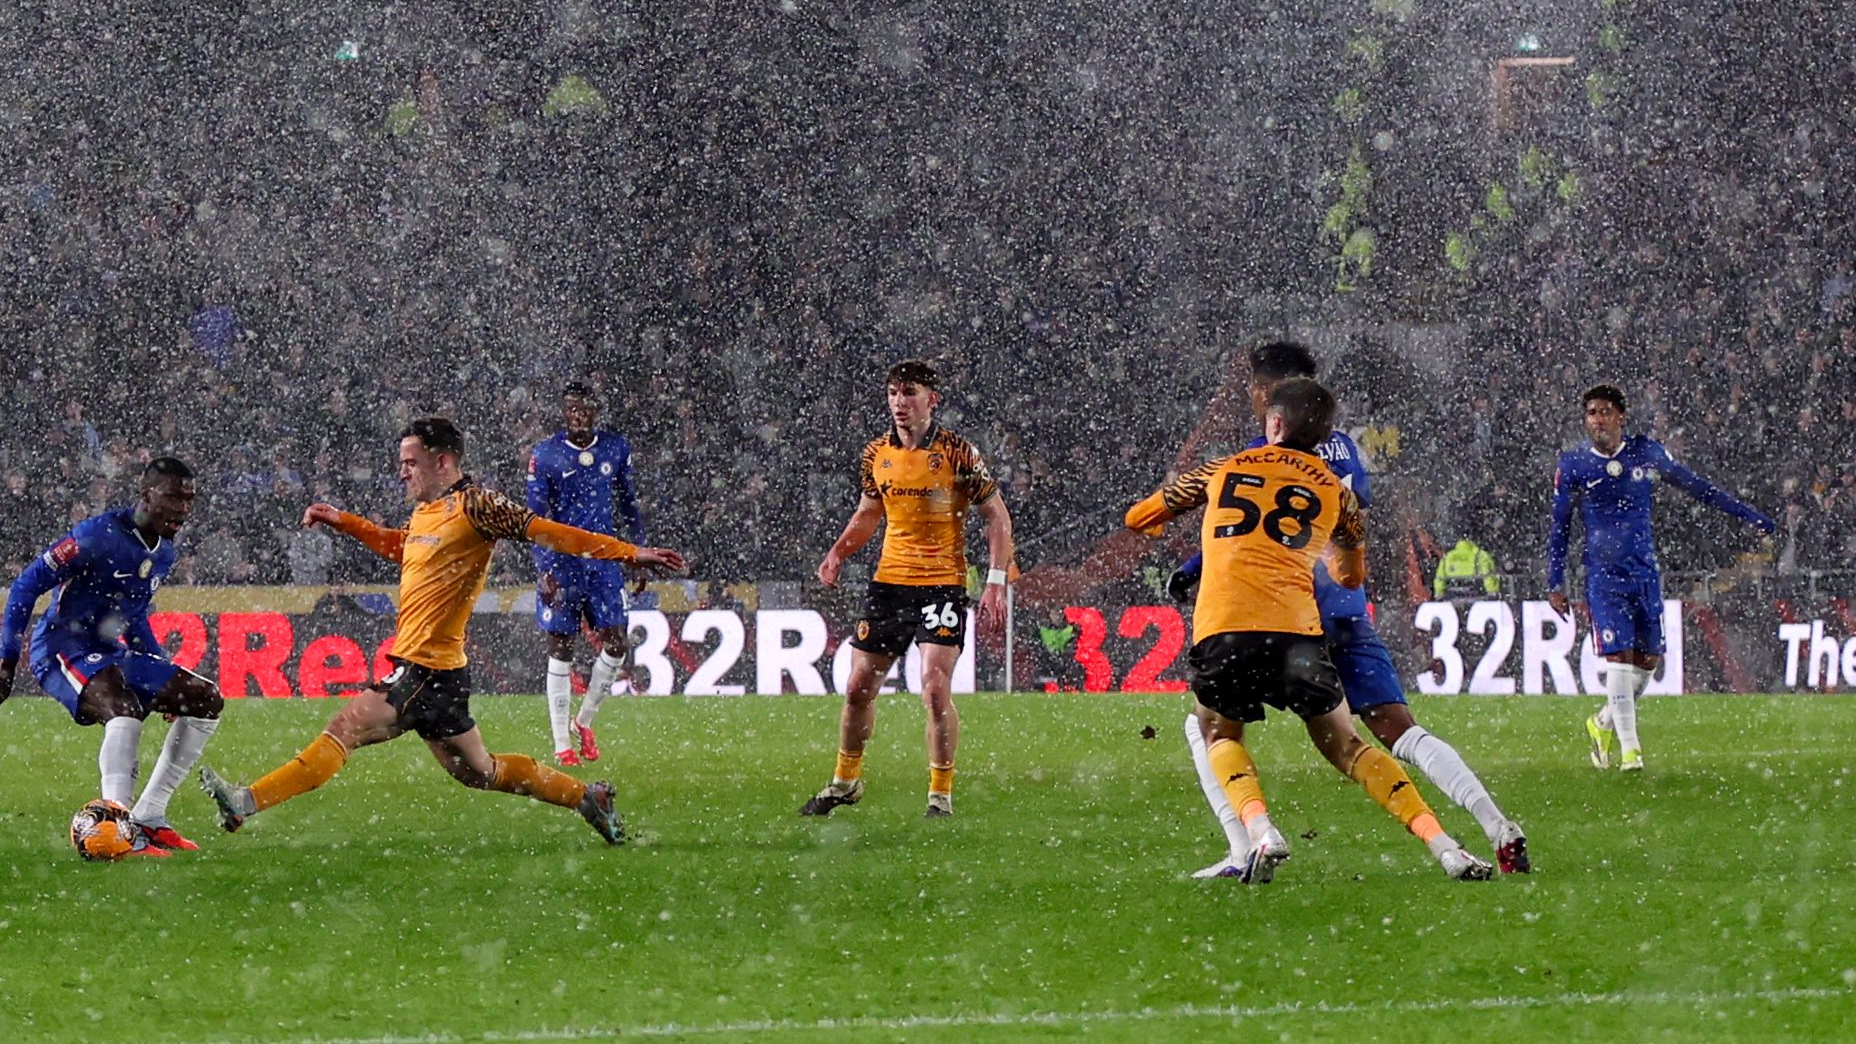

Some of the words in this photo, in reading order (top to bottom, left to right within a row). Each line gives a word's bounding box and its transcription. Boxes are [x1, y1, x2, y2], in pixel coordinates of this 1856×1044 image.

[1236, 453, 1334, 486] McCARTHY
[1213, 472, 1322, 549] 58
[921, 602, 959, 630] 36
[147, 612, 398, 698] 2Re
